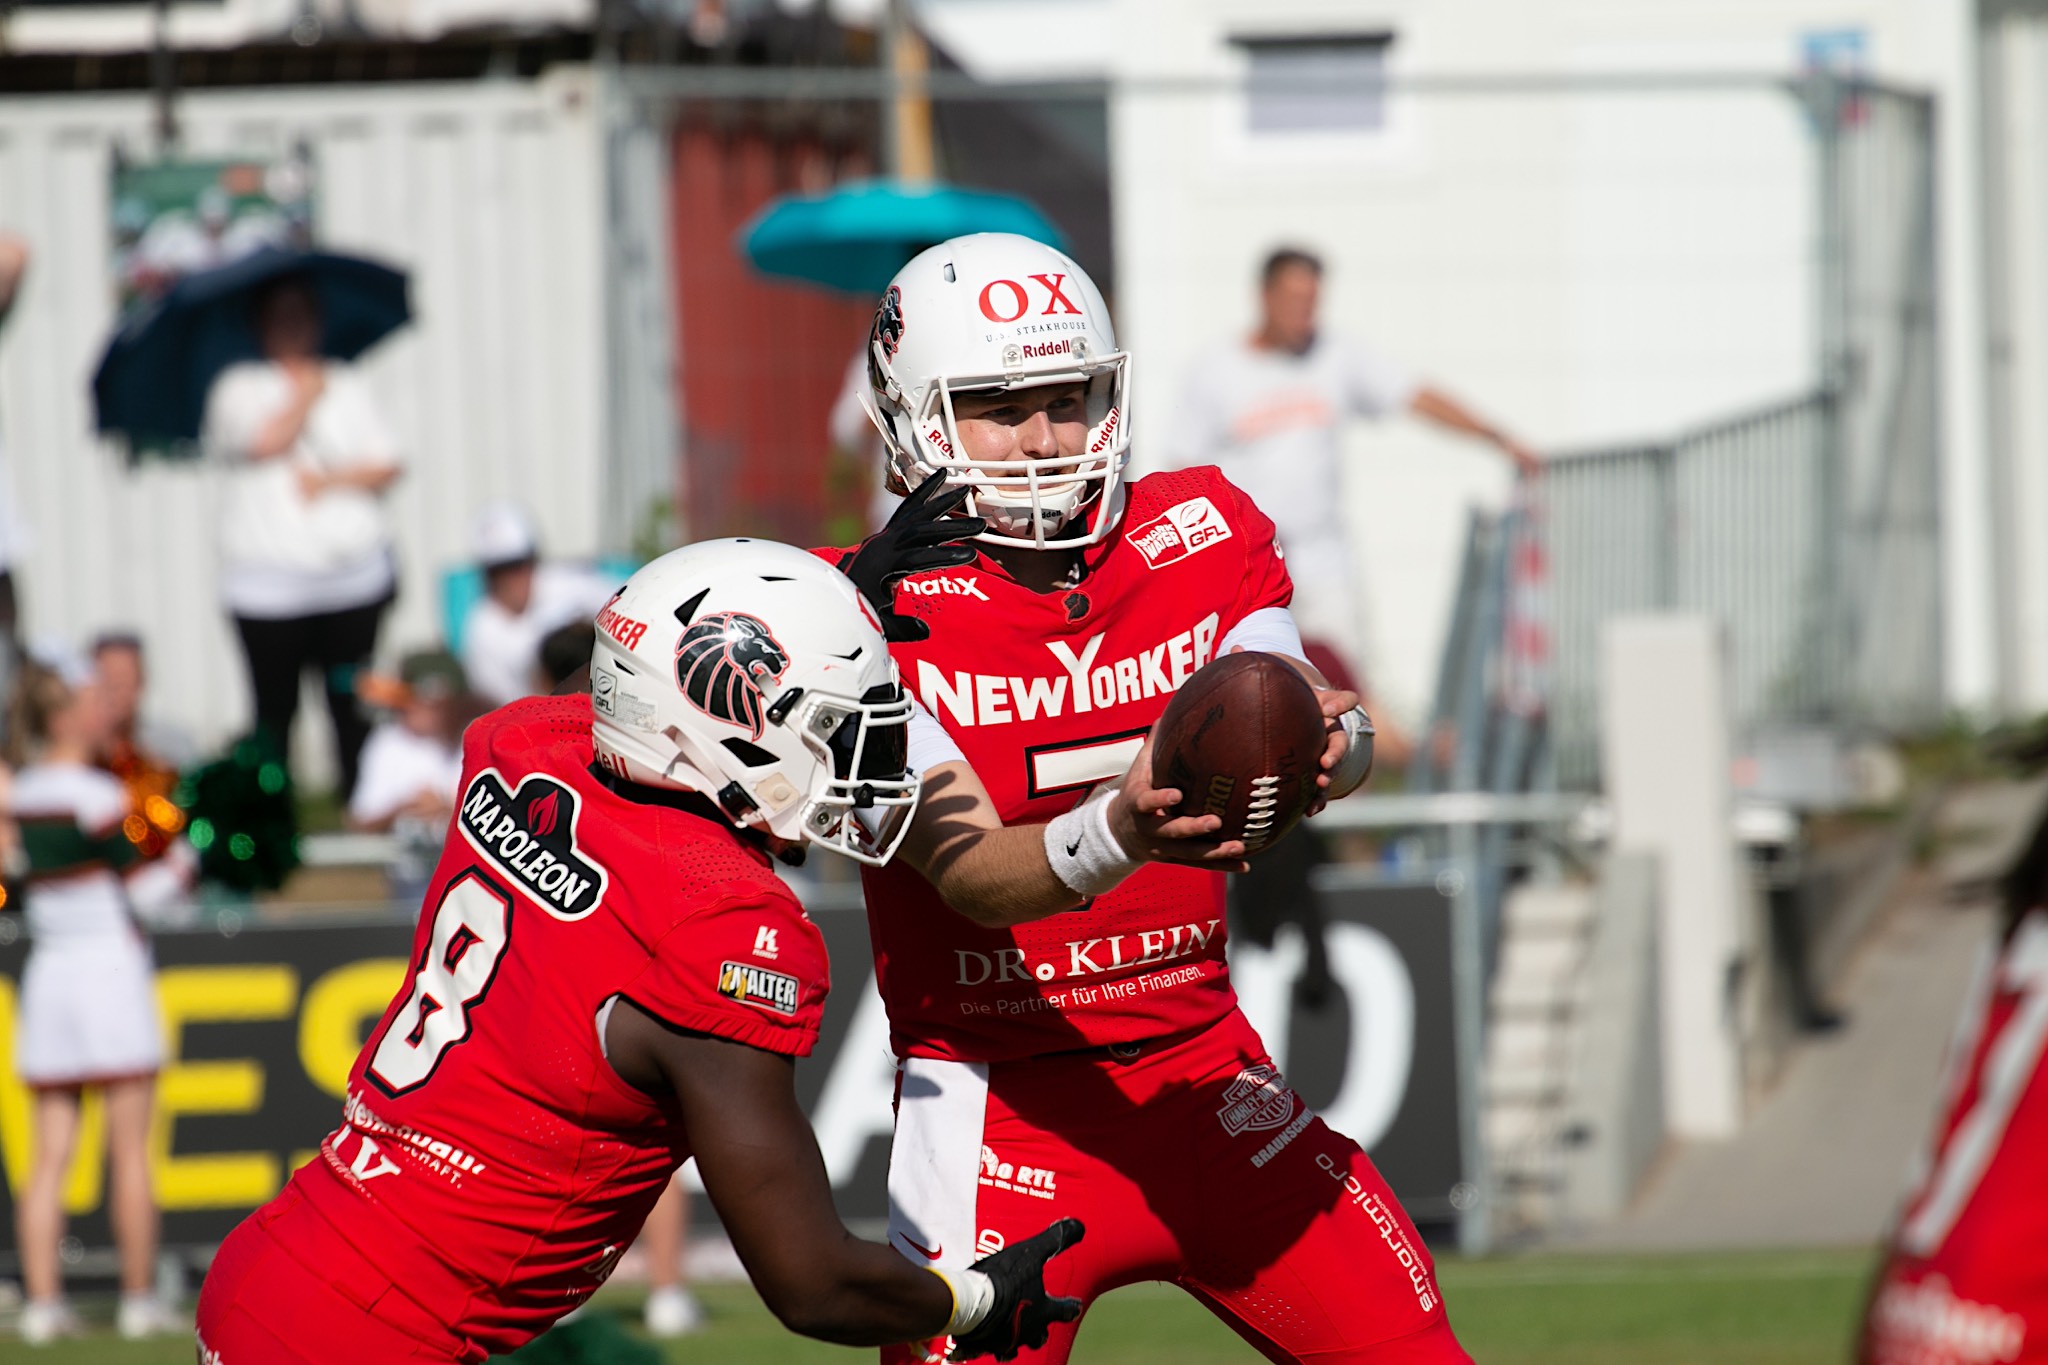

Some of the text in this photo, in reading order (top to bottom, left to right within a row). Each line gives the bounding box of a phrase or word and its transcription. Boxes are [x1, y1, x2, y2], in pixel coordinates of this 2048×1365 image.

[978, 273, 1083, 323] OX
[1016, 322, 1087, 336] STEAKHOUSE
[1022, 340, 1071, 358] Riddell
[1133, 524, 1175, 547] SHARK
[1142, 530, 1181, 561] WATER
[1188, 524, 1227, 548] GFL
[463, 784, 591, 908] NAPOLEON
[753, 925, 779, 953] K
[1065, 919, 1220, 977] KLEIN
[363, 863, 514, 1101] 8
[725, 964, 796, 1006] WALTER
[960, 965, 1205, 1015] Die Partner für Ihre Finanzen.
[994, 1178, 1012, 1191] Hits
[1012, 1184, 1028, 1195] von
[1028, 1187, 1055, 1201] heute!
[1016, 1165, 1057, 1190] RTL
[1372, 1192, 1400, 1229] SENSORS
[1315, 1153, 1434, 1312] smartmicro
[1397, 1228, 1428, 1276] MICROWAVE
